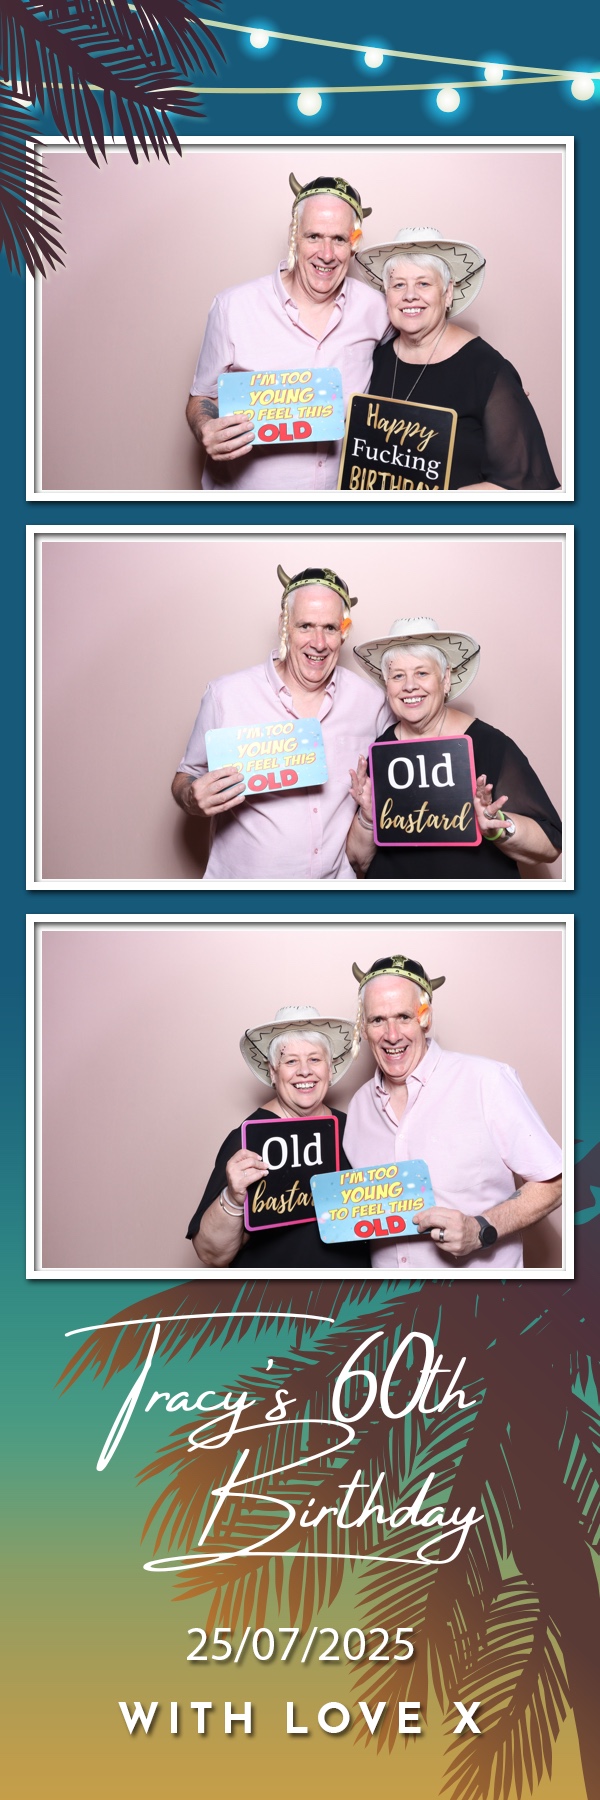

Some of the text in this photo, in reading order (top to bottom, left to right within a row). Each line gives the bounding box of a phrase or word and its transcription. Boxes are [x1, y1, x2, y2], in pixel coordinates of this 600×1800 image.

[250, 370, 312, 386] I'M TOO
[249, 387, 315, 406] YOUNG
[257, 408, 293, 421] FEEL
[297, 405, 334, 418] THIS
[258, 420, 312, 442] OLD
[366, 403, 439, 452] Happy
[352, 438, 442, 480] Fucking
[349, 466, 440, 490] BIRTH
[236, 722, 294, 740] I'M TOO
[237, 738, 298, 758] YOUNG
[246, 758, 280, 772] FEEL
[284, 752, 316, 767] THIS
[388, 753, 455, 790] Old
[248, 769, 298, 792] OLD
[380, 798, 472, 834] bastard
[262, 1132, 323, 1170] Old
[340, 1165, 398, 1186] I'M TOO
[341, 1182, 404, 1204] YOUNG
[328, 1198, 424, 1221] TO FEEL THIS
[354, 1215, 406, 1238] OLD
